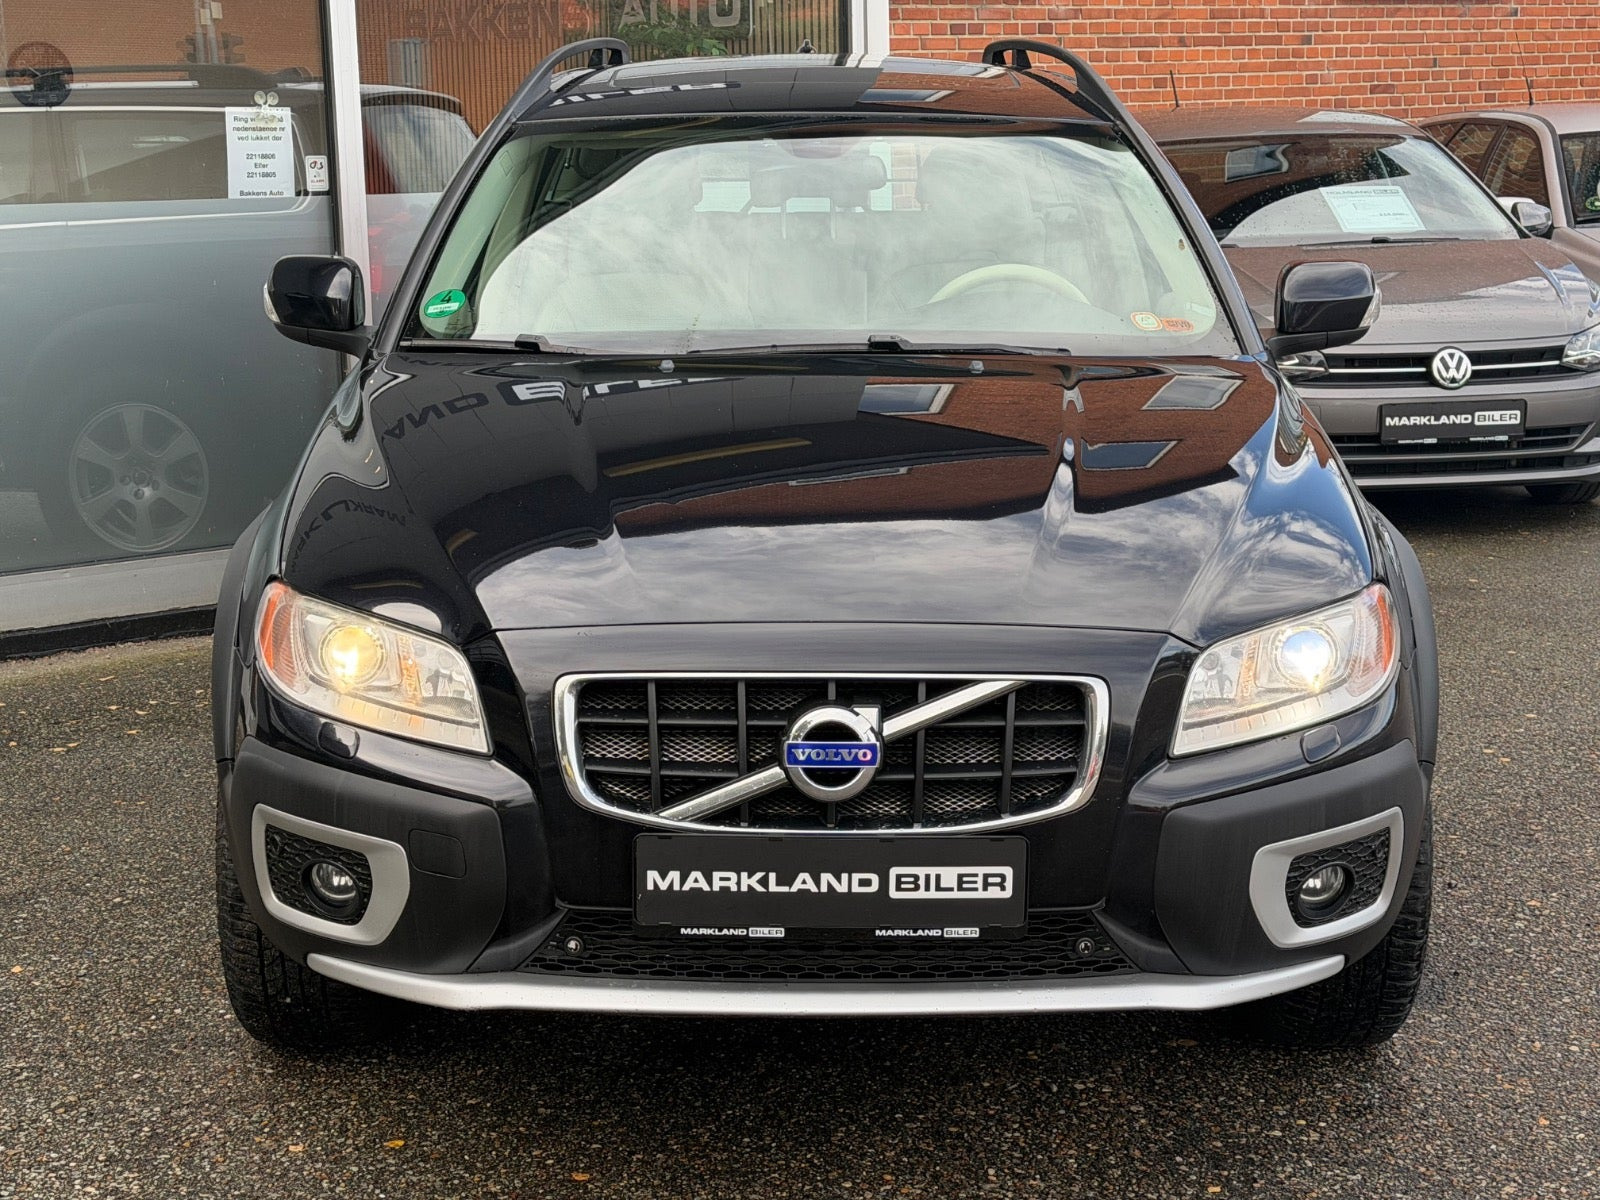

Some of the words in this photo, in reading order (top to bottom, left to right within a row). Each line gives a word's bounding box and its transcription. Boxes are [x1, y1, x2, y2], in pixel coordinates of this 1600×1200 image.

[233, 115, 249, 124] Ring
[440, 290, 453, 303] 4
[1385, 414, 1472, 427] MARKLAND
[1477, 412, 1518, 423] BILER
[791, 748, 873, 762] VOLVO
[646, 869, 880, 893] MARKLAND
[894, 872, 1008, 893] BILER
[680, 927, 747, 936] MARKLAND
[750, 928, 783, 936] BILER
[875, 929, 942, 937] MARKLAND
